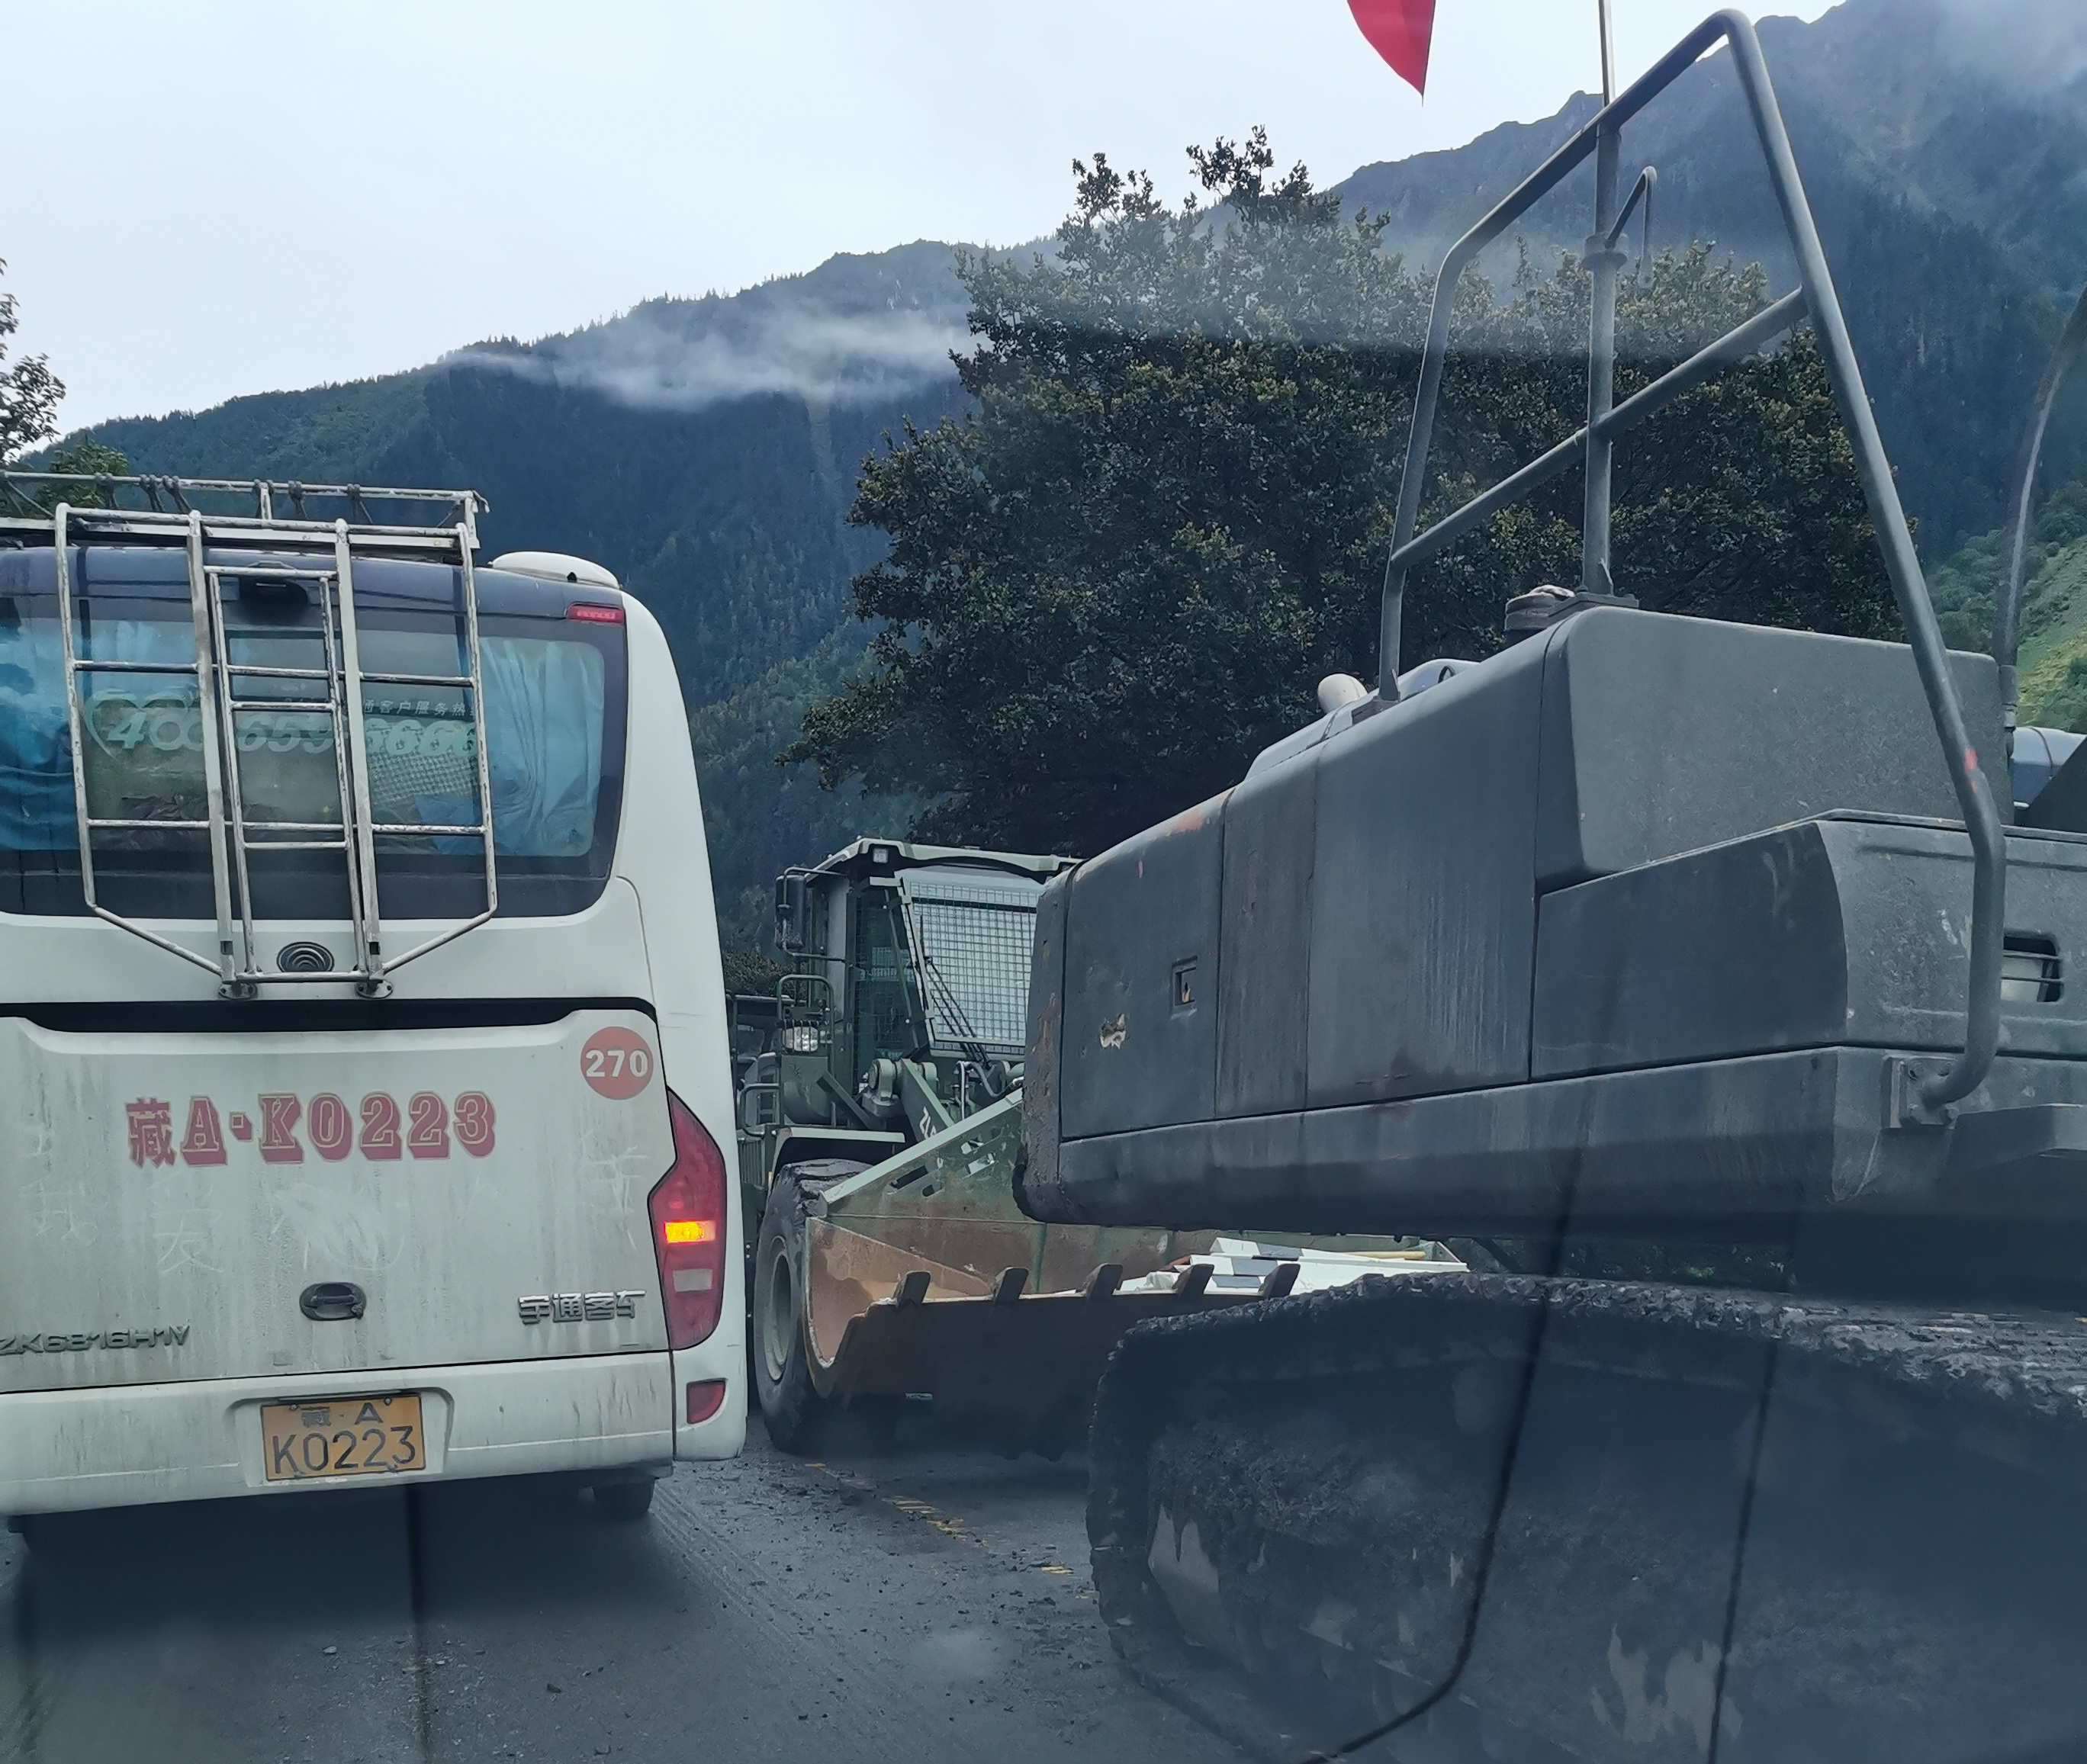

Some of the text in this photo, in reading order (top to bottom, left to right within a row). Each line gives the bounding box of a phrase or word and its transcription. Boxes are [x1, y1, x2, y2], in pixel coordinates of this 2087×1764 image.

[364, 699, 475, 718] 通客户服务热
[585, 1049, 648, 1078] 270
[518, 1290, 646, 1325] 宇通客车
[272, 1425, 416, 1474] K0223
